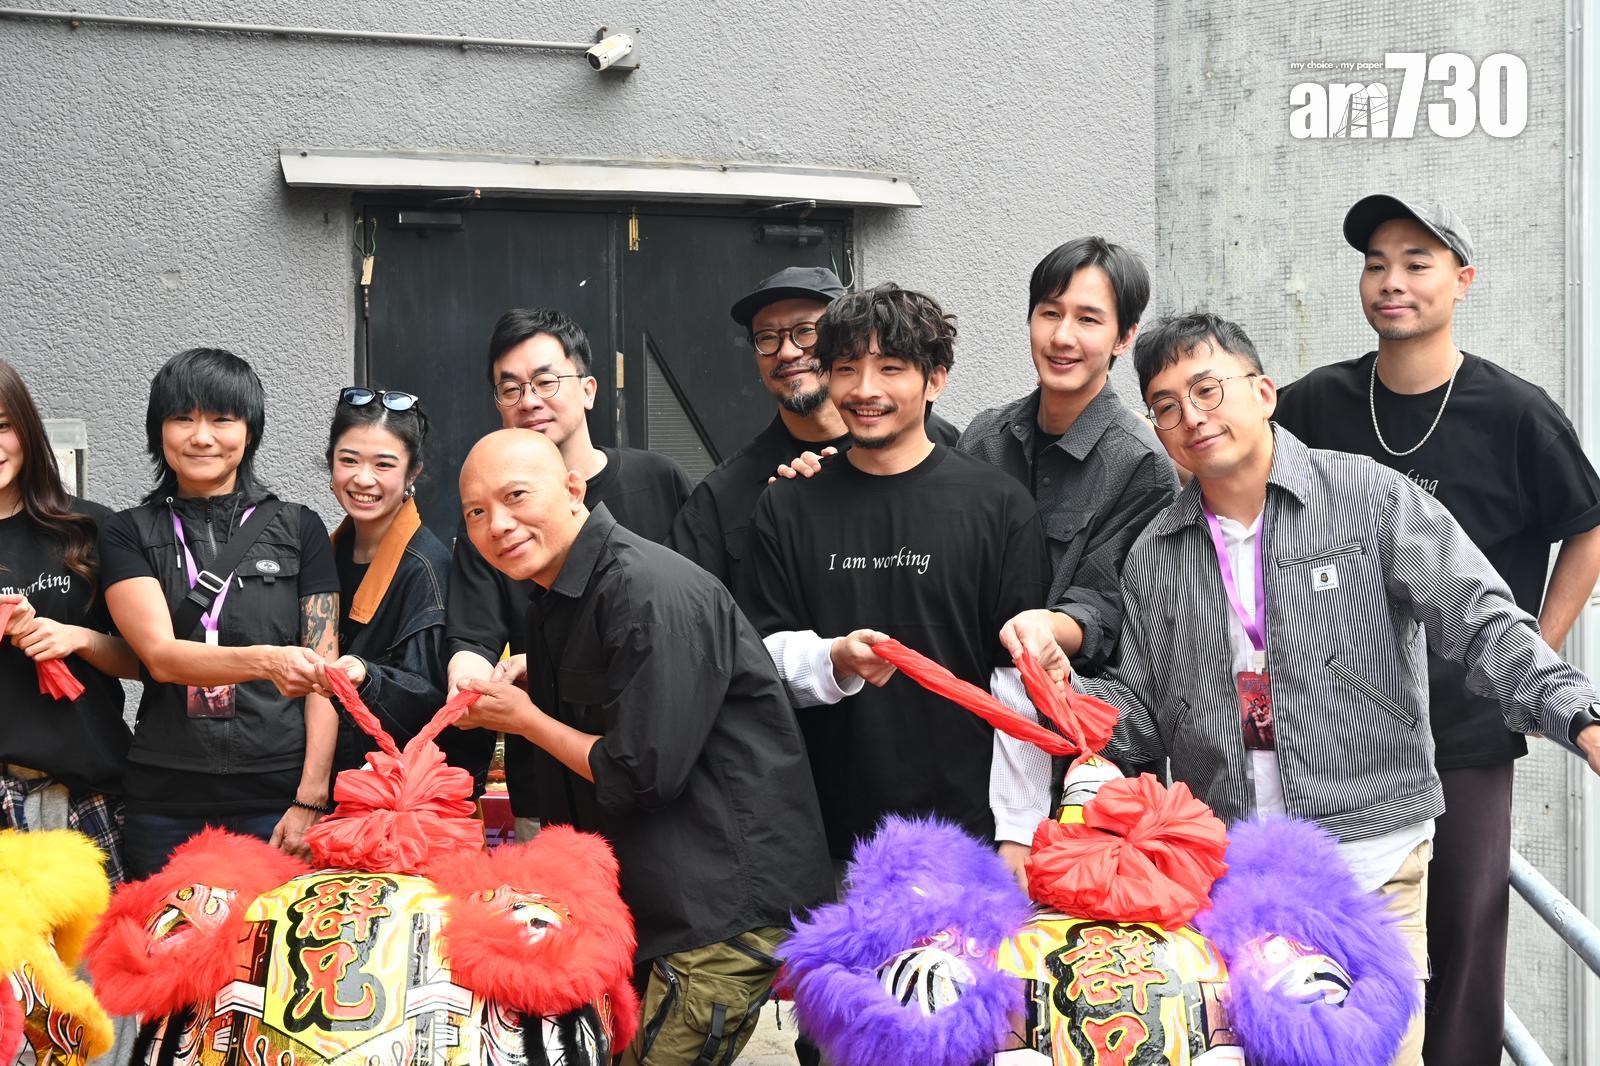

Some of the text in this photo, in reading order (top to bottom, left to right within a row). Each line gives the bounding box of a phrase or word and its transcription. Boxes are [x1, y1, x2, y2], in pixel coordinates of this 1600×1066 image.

[828, 546, 931, 575] I am working
[1, 572, 71, 597] m working
[291, 877, 392, 1022] 群兄
